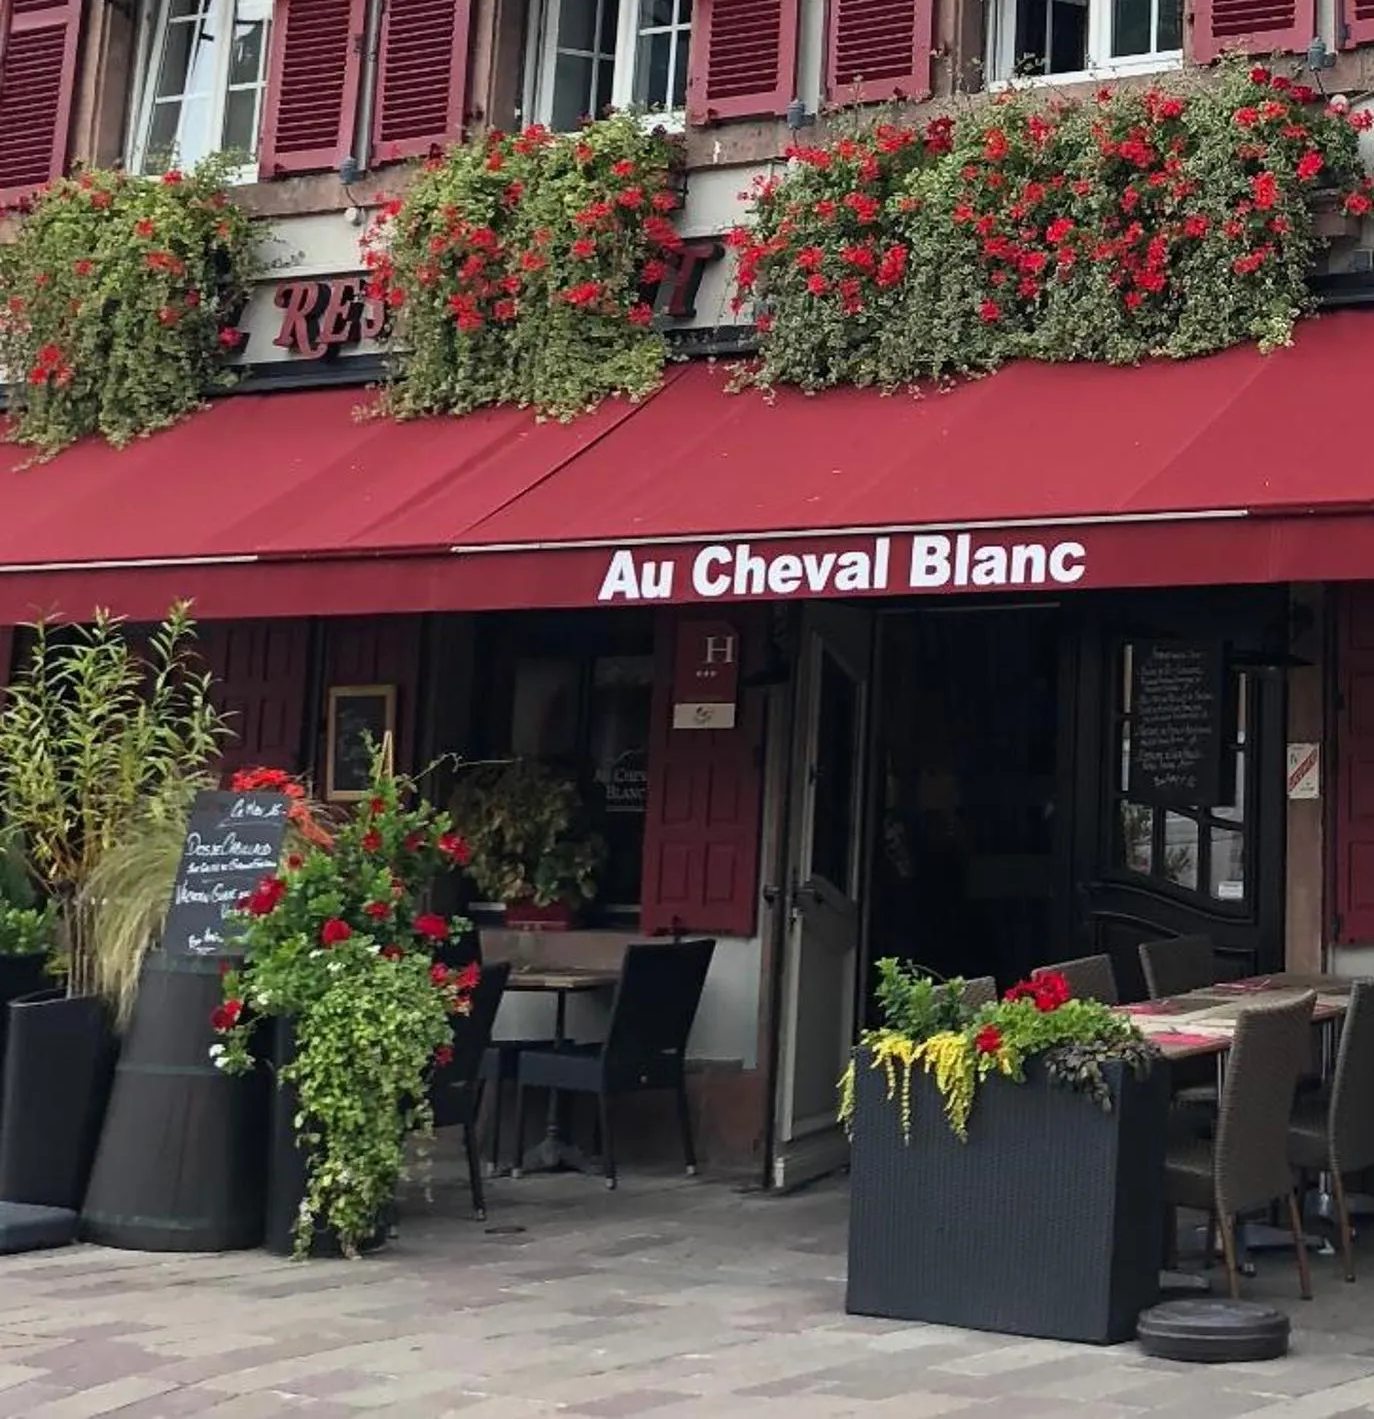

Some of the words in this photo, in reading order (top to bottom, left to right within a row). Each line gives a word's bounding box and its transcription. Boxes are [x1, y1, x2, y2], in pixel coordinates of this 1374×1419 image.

[598, 549, 674, 600] Au
[692, 537, 891, 597] Cheval
[910, 533, 1087, 588] Blanc
[706, 637, 734, 663] H
